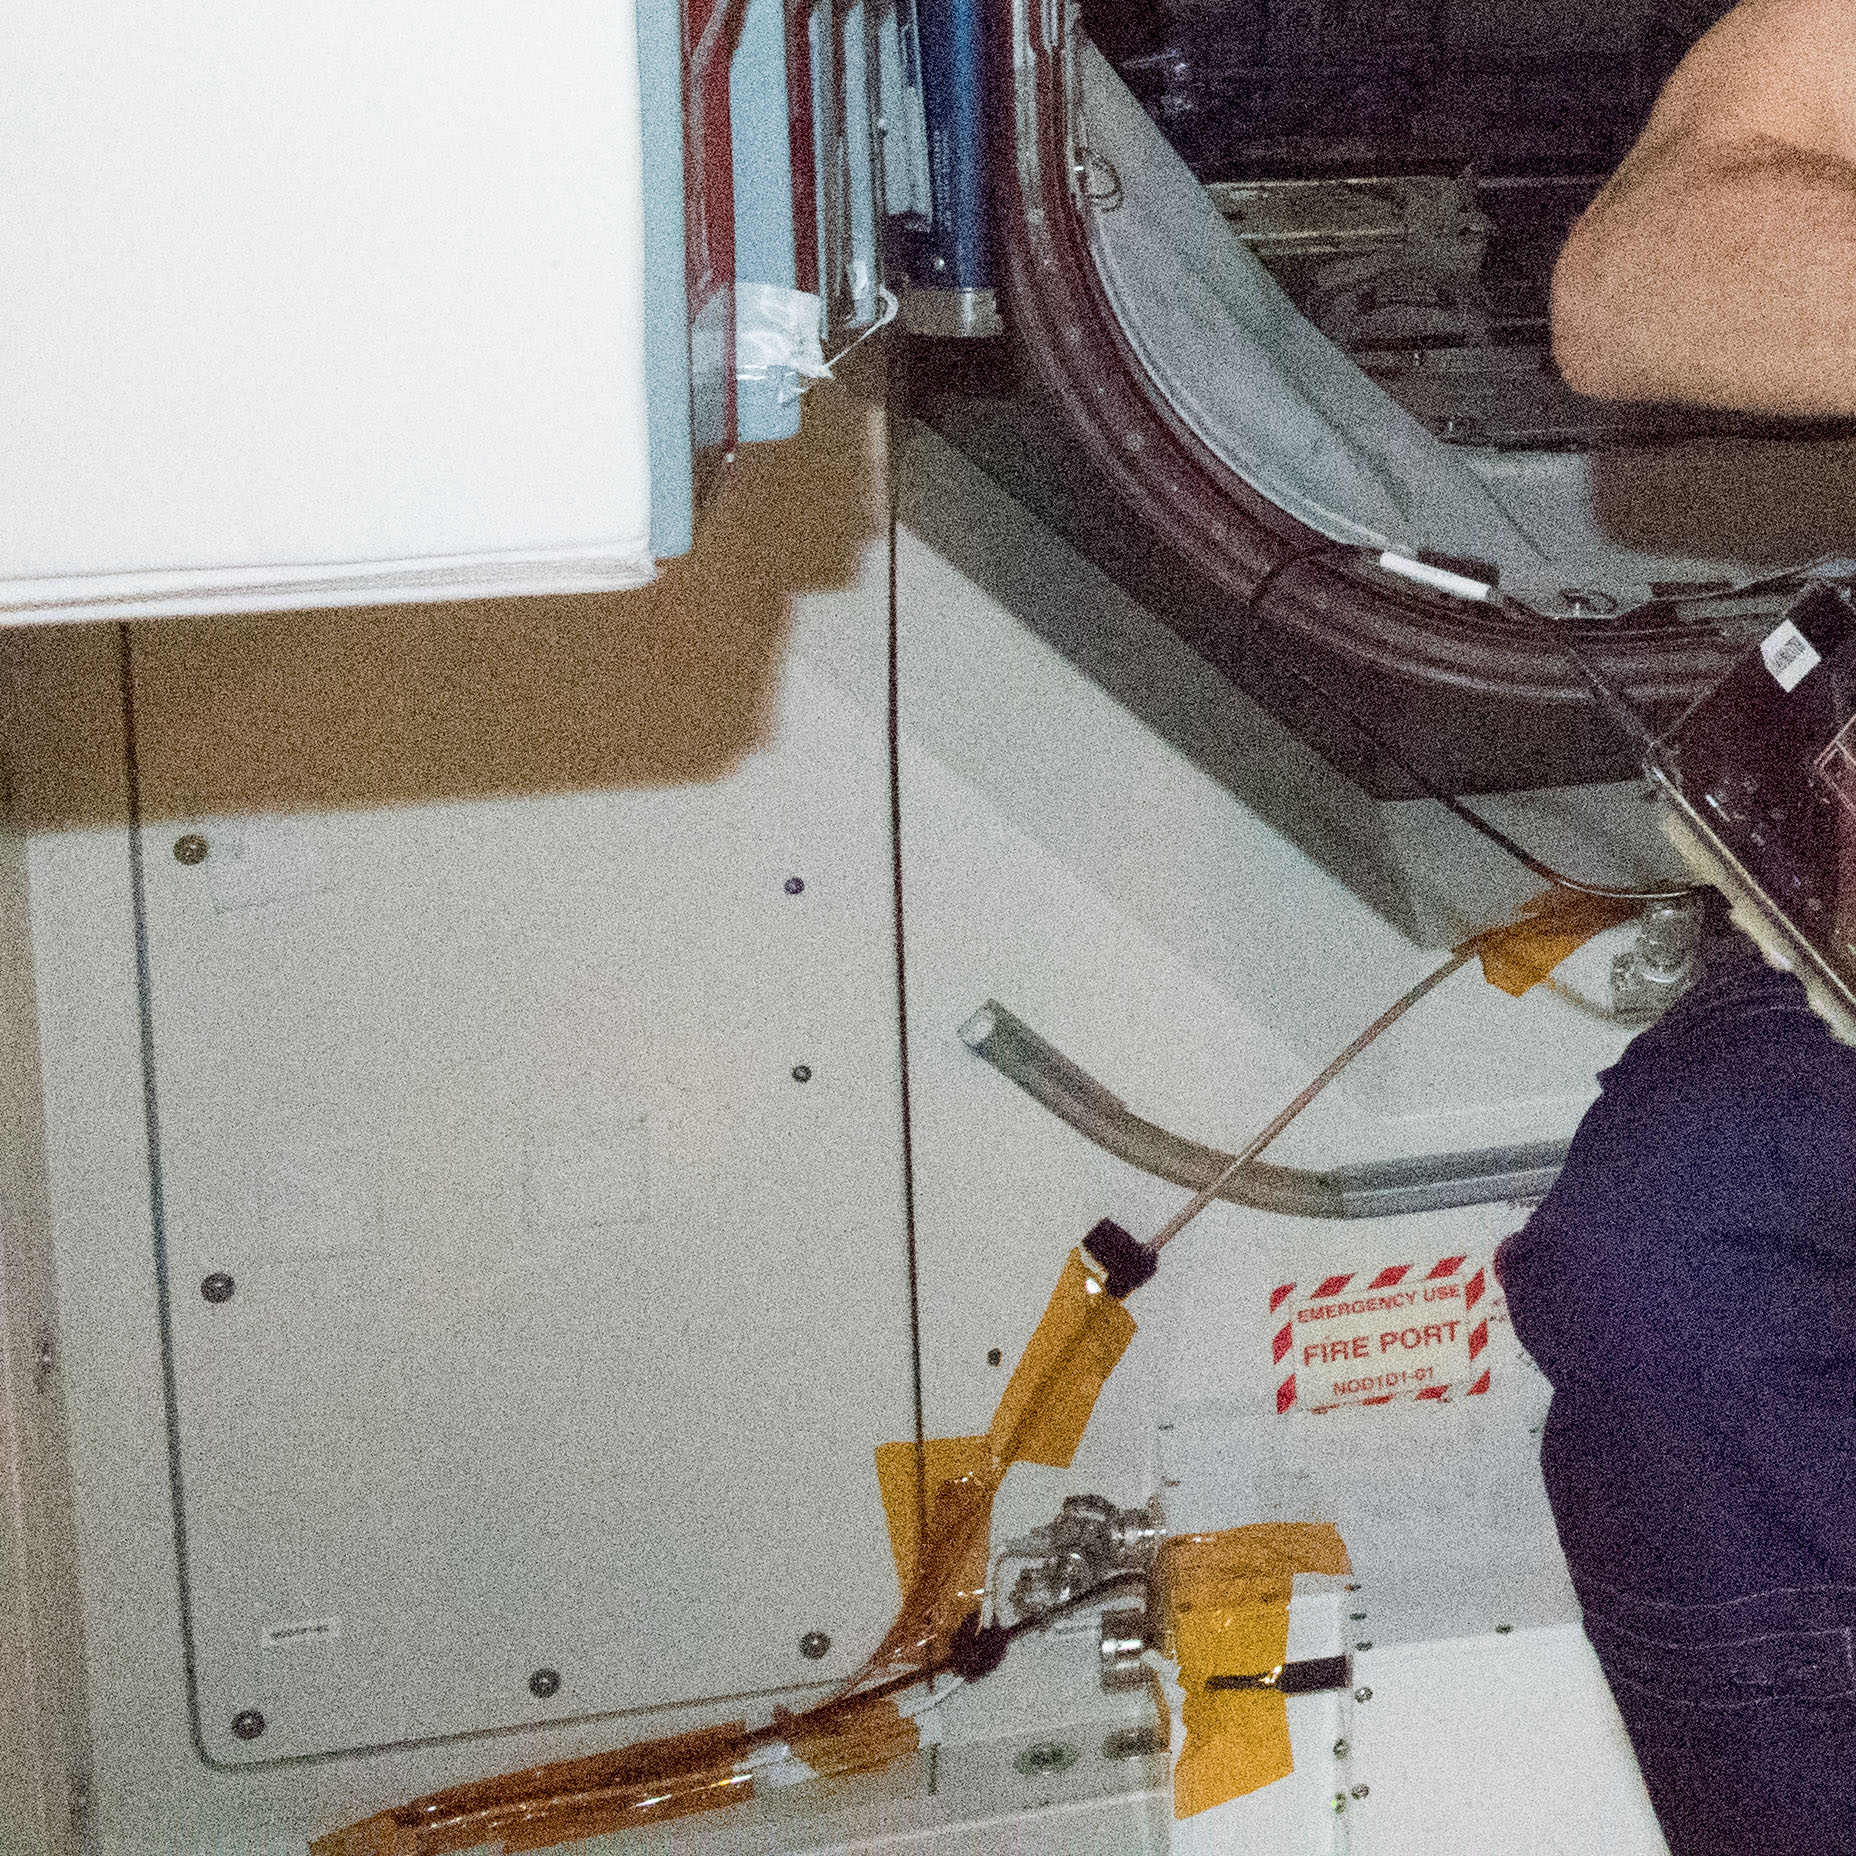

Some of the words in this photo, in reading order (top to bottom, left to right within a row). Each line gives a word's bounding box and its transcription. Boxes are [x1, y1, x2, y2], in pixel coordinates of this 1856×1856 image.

[1297, 1292, 1417, 1323] EMERGENCY
[1423, 1284, 1460, 1303] USE
[1303, 1336, 1369, 1366] FIRE
[1380, 1321, 1460, 1353] PORT
